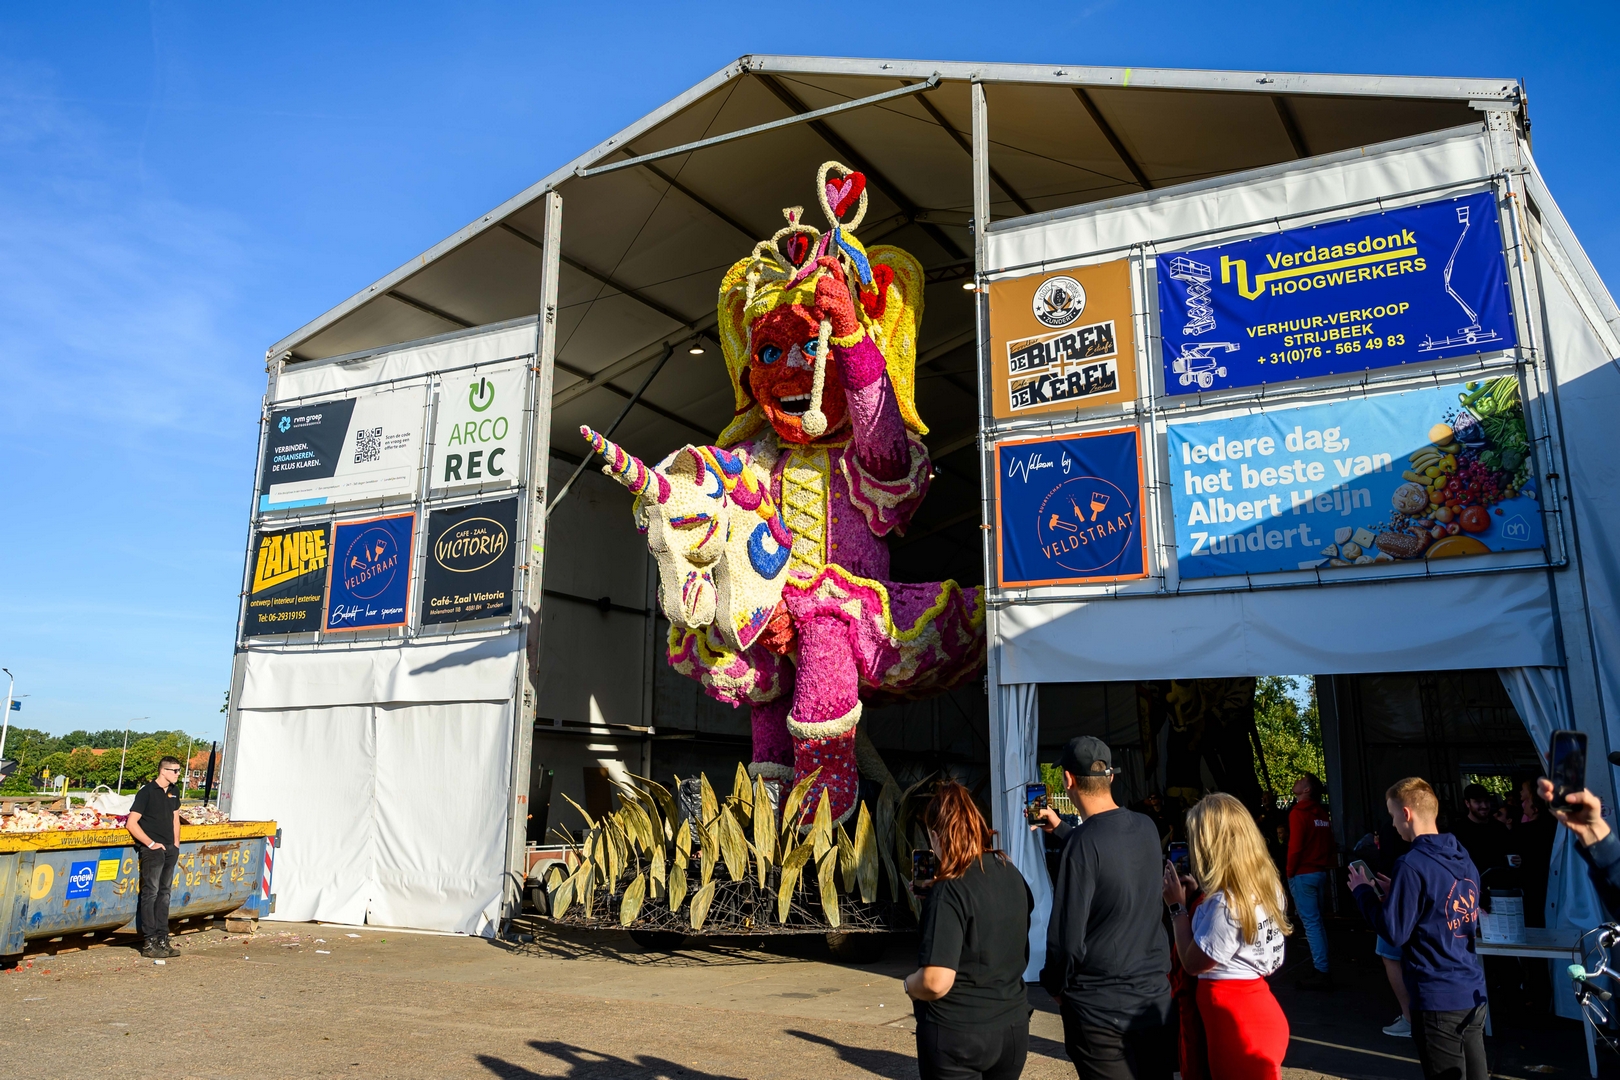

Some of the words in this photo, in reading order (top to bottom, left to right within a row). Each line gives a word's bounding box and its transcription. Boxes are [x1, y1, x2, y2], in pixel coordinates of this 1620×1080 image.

[1266, 229, 1417, 269] Verdaasdonk
[1271, 257, 1427, 296] HOOGWERKERS
[1045, 313, 1073, 324] ZUNDERT
[1246, 302, 1409, 338] VERHUUR-VERKOOP
[1010, 355, 1026, 372] DE
[1026, 323, 1114, 368] BUREN
[1257, 356, 1266, 364] +
[1270, 347, 1322, 365] 31(0)76
[1335, 341, 1360, 356] 565
[1365, 337, 1382, 351] 49
[1387, 333, 1405, 347] 83
[1284, 323, 1374, 347] STRIJBEEK
[1011, 390, 1029, 408] DE
[448, 416, 508, 447] ARCO
[1182, 435, 1275, 465] Iedere
[1285, 426, 1350, 453] dag,
[273, 451, 315, 463] ORGANISEREN.
[274, 443, 308, 453] VERBINDEN.
[272, 464, 280, 472] DE
[280, 462, 295, 471] KLUS
[296, 459, 321, 469] KLAREN.
[444, 447, 506, 482] REC
[1184, 468, 1233, 495] het
[1240, 459, 1324, 489] beste
[1333, 452, 1393, 478] van
[1187, 484, 1282, 526] Albert
[1291, 484, 1371, 516] Heijn
[439, 532, 504, 560] VICTORIA
[456, 530, 469, 538] CAFE
[1042, 512, 1133, 559] VELDSTRAAT
[1190, 523, 1320, 556] Zundert.
[252, 529, 327, 594] LANGE
[300, 555, 327, 576] LAT
[344, 554, 398, 590] VELDSTRAAT
[250, 599, 271, 607] ontwerp
[273, 596, 295, 605] interieur
[298, 594, 320, 603] exterieur
[454, 592, 471, 604] Zaal
[473, 590, 504, 601] Victoria
[185, 871, 202, 887] 92
